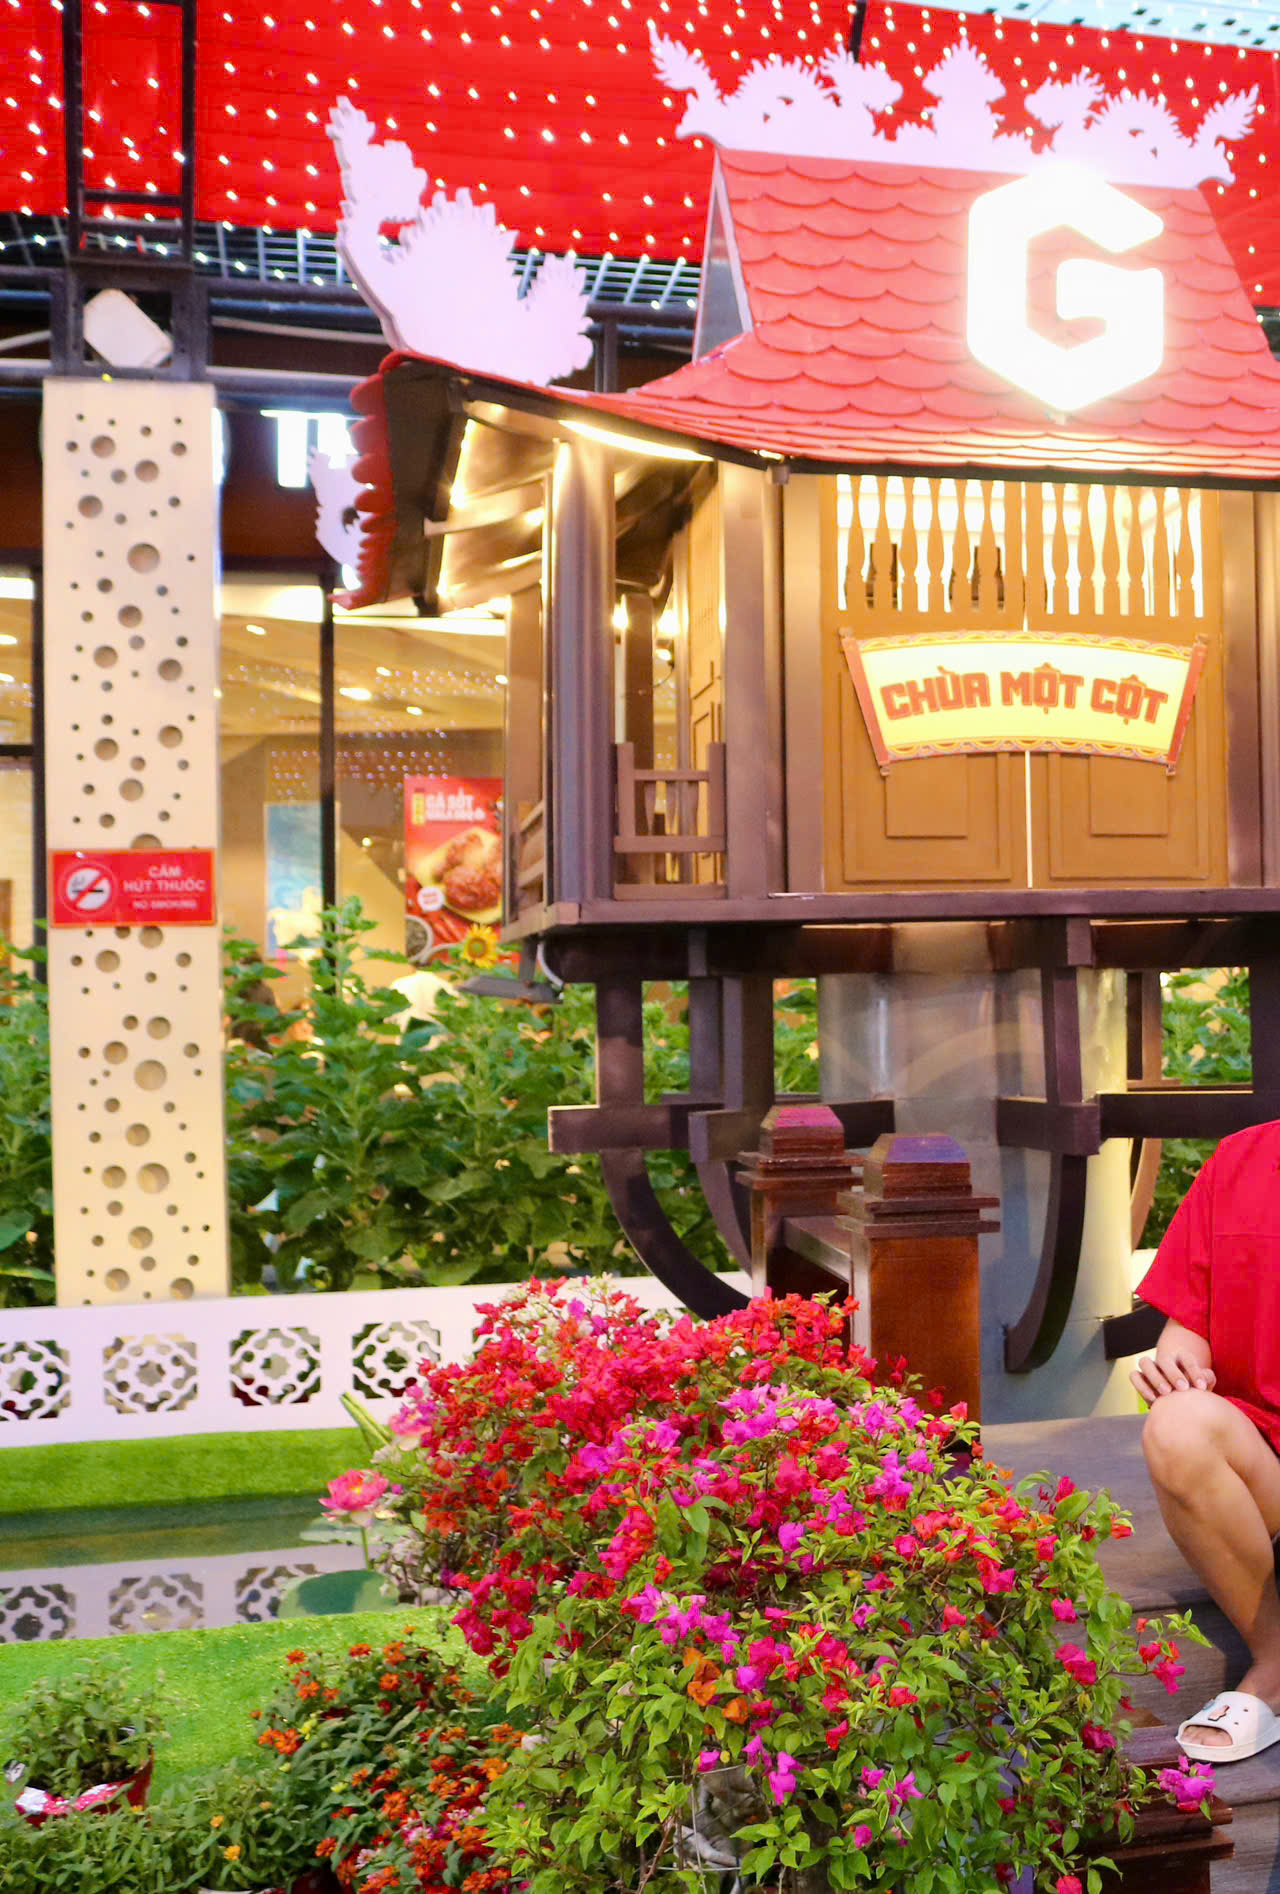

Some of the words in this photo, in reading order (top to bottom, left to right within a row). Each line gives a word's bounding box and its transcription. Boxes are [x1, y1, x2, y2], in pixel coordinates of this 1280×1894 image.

[966, 160, 1164, 411] G
[879, 665, 992, 721] CHÙA
[1000, 662, 1085, 714] MỘT
[1090, 674, 1169, 725] CỘT
